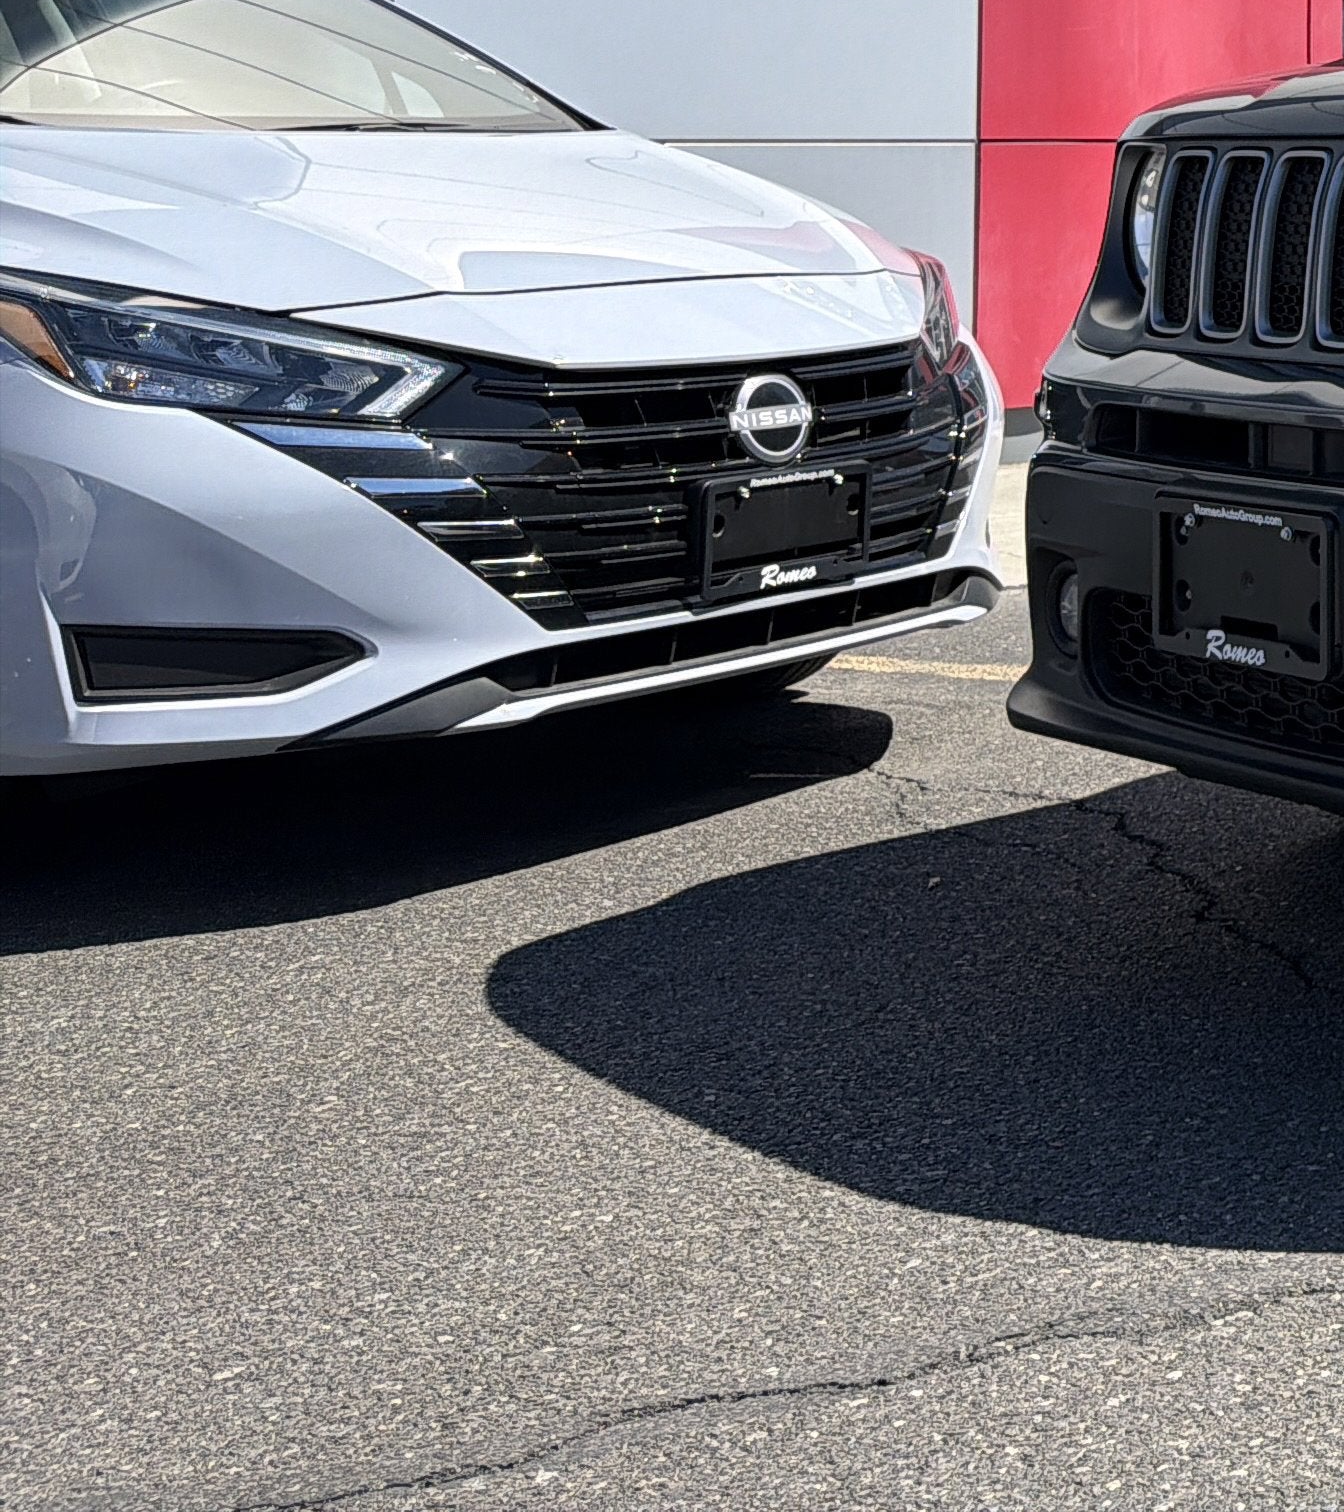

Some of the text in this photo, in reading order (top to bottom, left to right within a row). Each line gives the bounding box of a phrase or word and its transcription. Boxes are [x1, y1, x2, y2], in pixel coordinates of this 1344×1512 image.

[730, 404, 812, 430] NISSAN
[1193, 502, 1284, 527] RomeoAutoGroup.com
[759, 563, 818, 590] Romeo
[1205, 628, 1267, 667] Romeo
